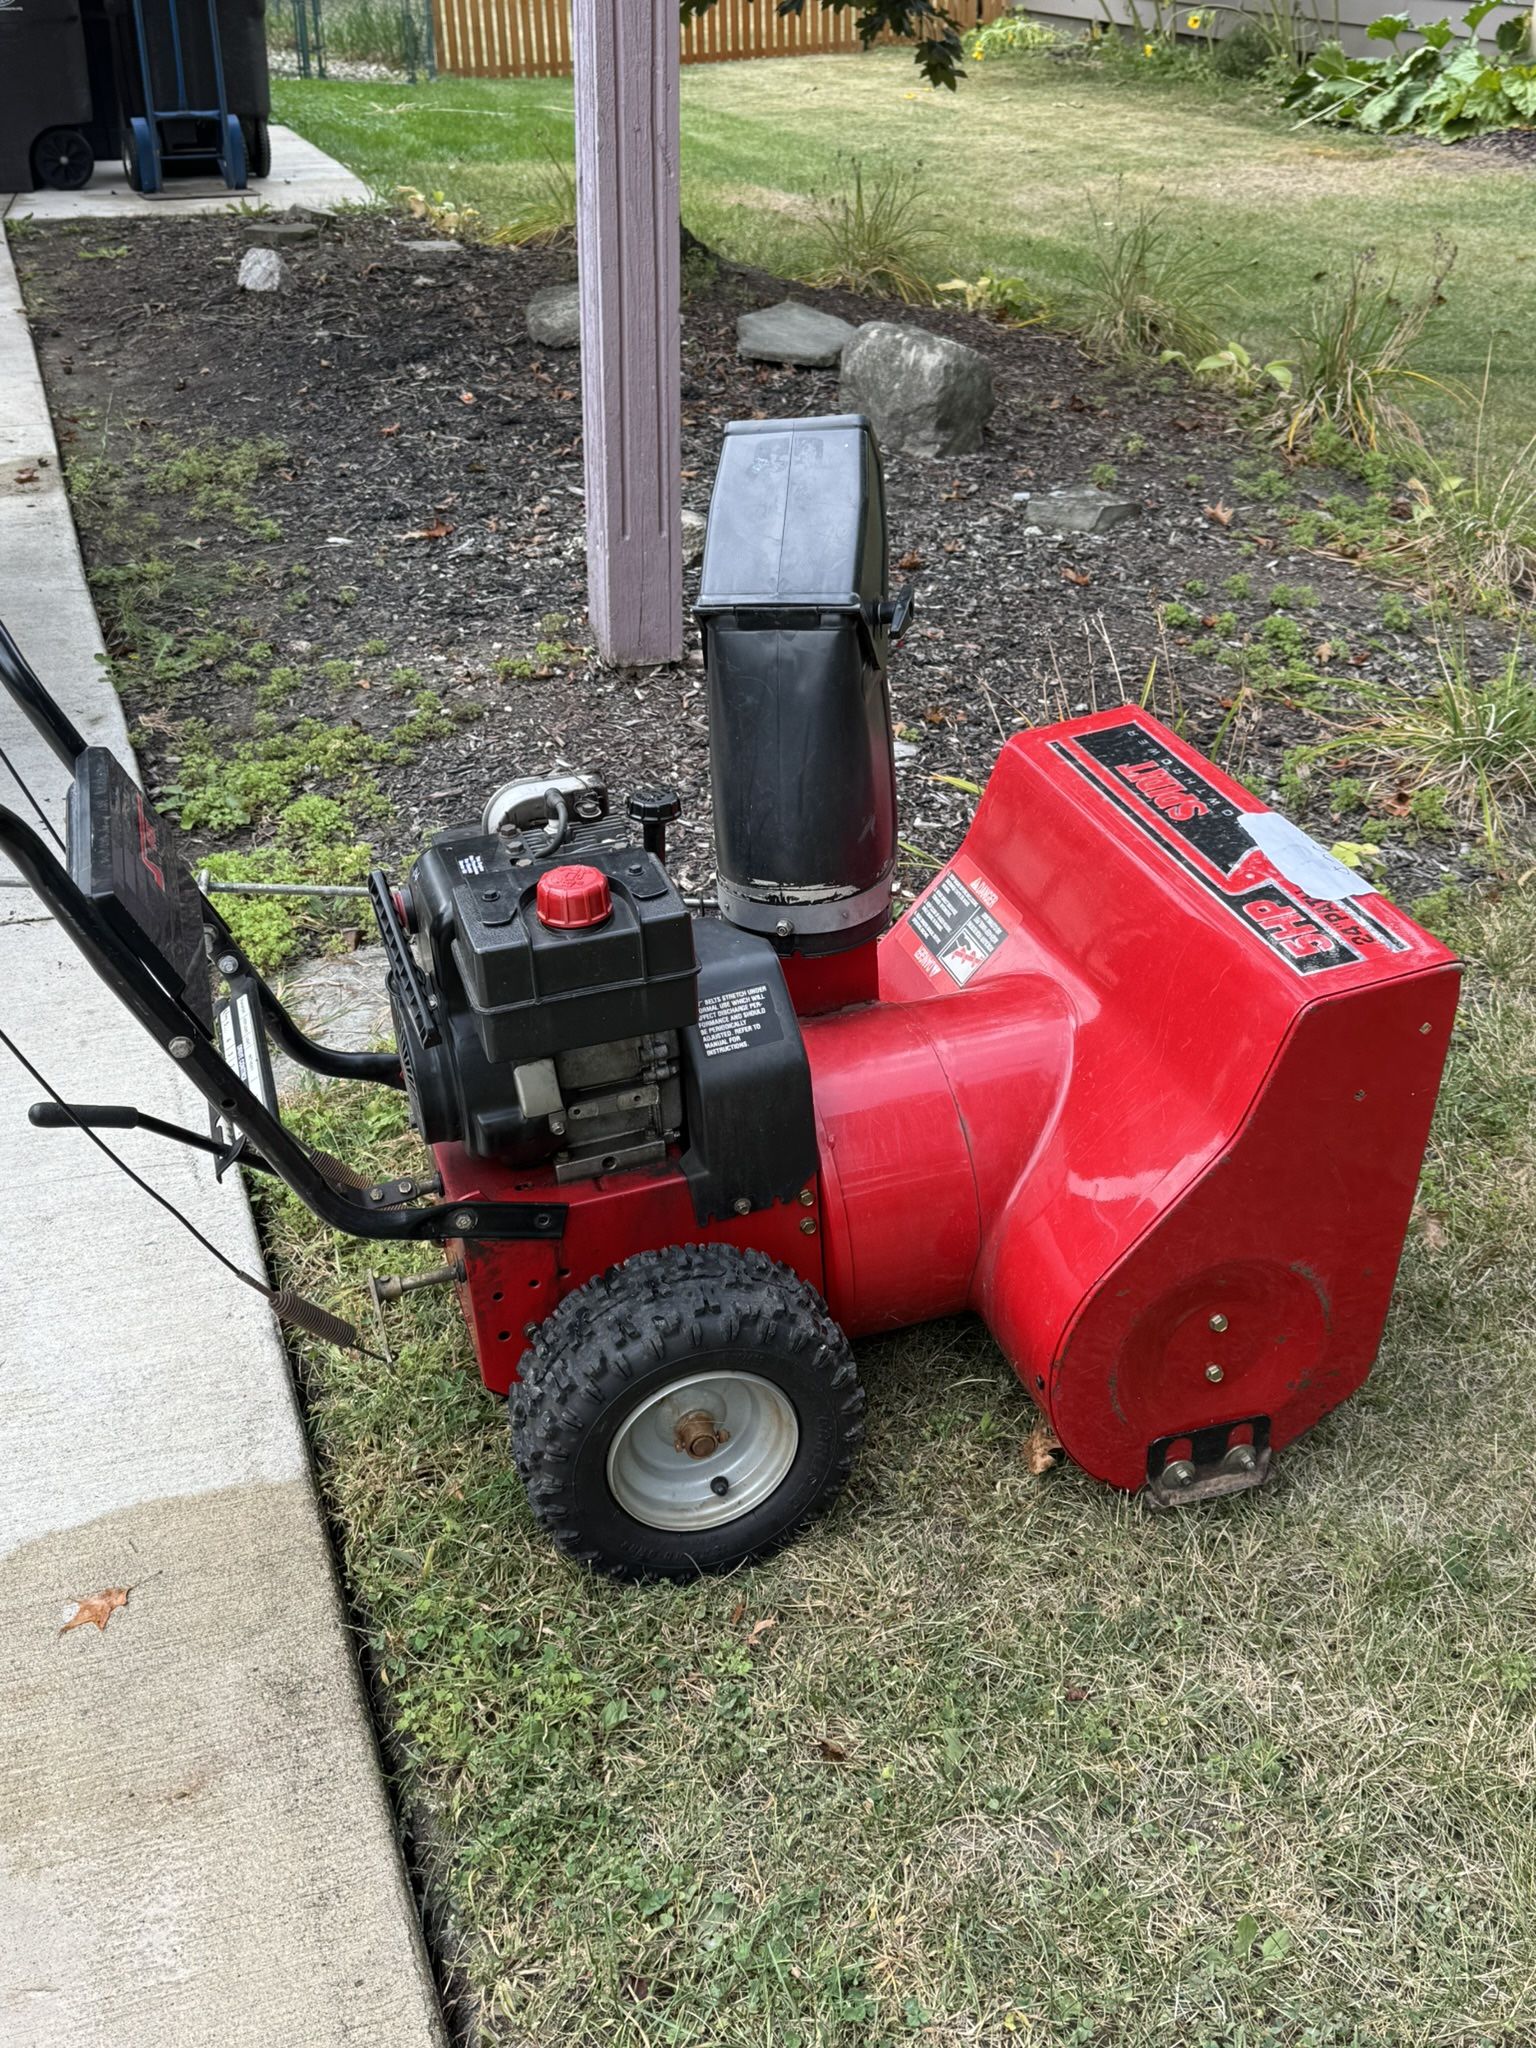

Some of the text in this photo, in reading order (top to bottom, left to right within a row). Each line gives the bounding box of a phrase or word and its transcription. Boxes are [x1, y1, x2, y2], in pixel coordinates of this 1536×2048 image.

[1127, 729, 1239, 820] OWTHROWER
[1115, 760, 1210, 821] SPIRIT
[1242, 899, 1335, 958] 5HP
[698, 993, 765, 1014] ORMAL USE WHICH WILL
[704, 996, 721, 1005] BELTS
[721, 990, 747, 1000] STRETCH
[747, 985, 767, 995] UNDER
[698, 1007, 766, 1028] FORMANCE AND SHOULD
[717, 1004, 749, 1016] DISCHARGE
[749, 1001, 762, 1009] PER-
[700, 1020, 747, 1036] BE PERIODICALLY
[702, 1030, 734, 1042] ADJUSTED.
[734, 1025, 753, 1034] REFER
[704, 1035, 741, 1049] MANUAL FOR
[706, 1041, 750, 1056] INSTRUCTIONS.
